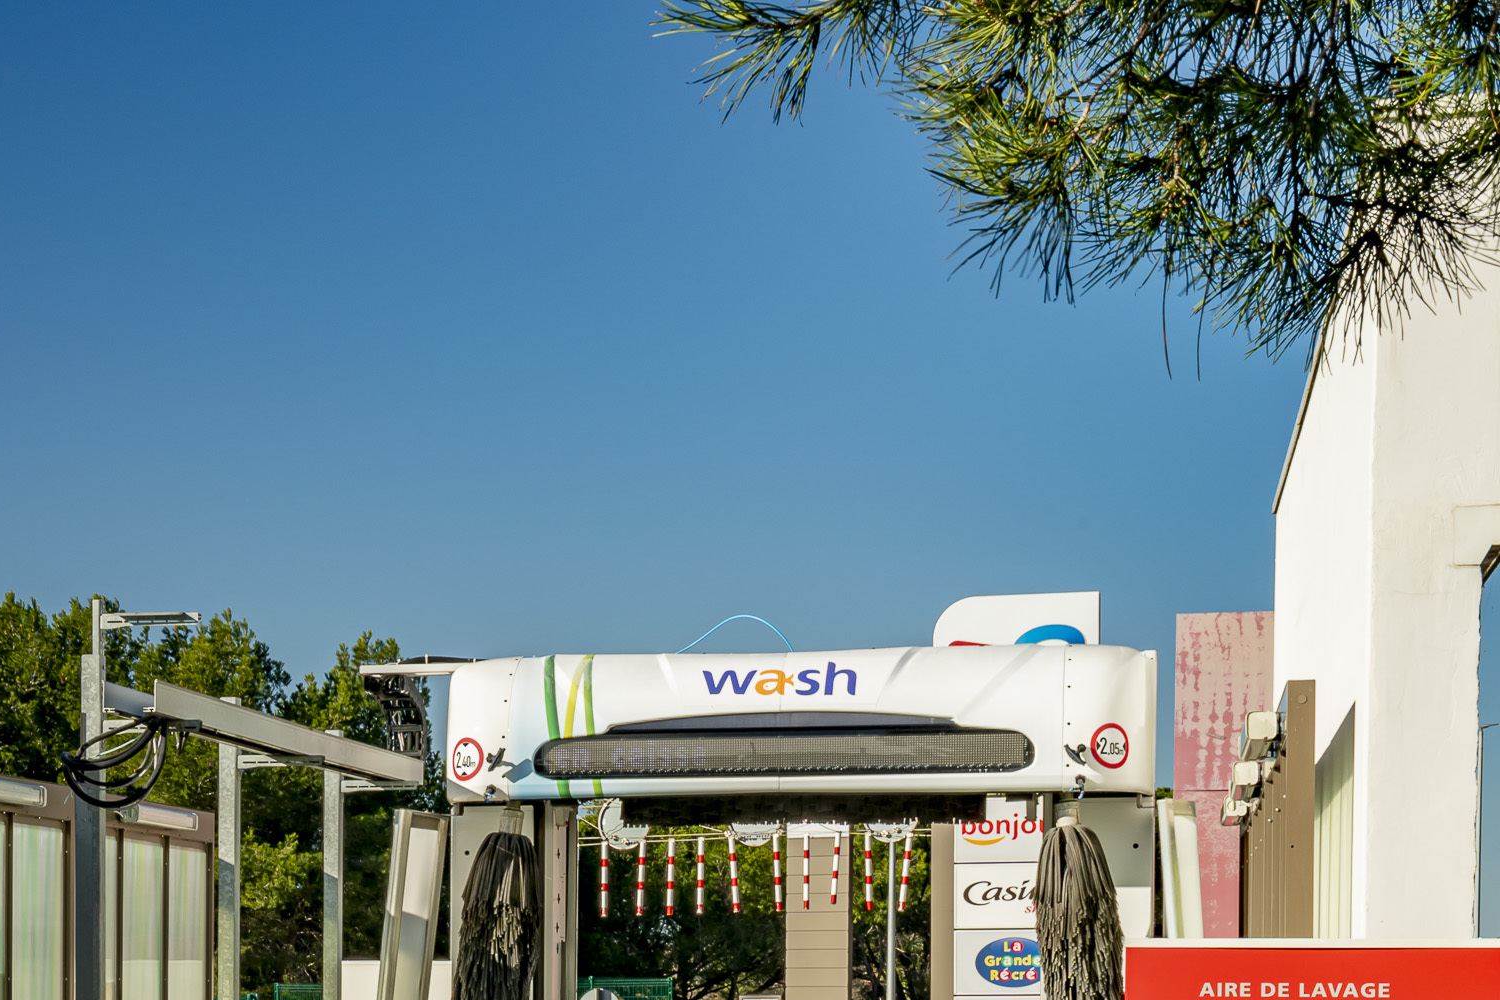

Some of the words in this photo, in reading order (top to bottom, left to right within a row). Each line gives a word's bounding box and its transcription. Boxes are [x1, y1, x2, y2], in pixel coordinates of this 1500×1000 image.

[702, 661, 857, 696] wash
[1004, 941, 1021, 952] La
[984, 955, 1040, 966] Grande
[991, 968, 1036, 981] Récré
[1199, 982, 1251, 997] AIRE
[1261, 983, 1289, 997] DE
[1299, 983, 1390, 998] LAVAGE
